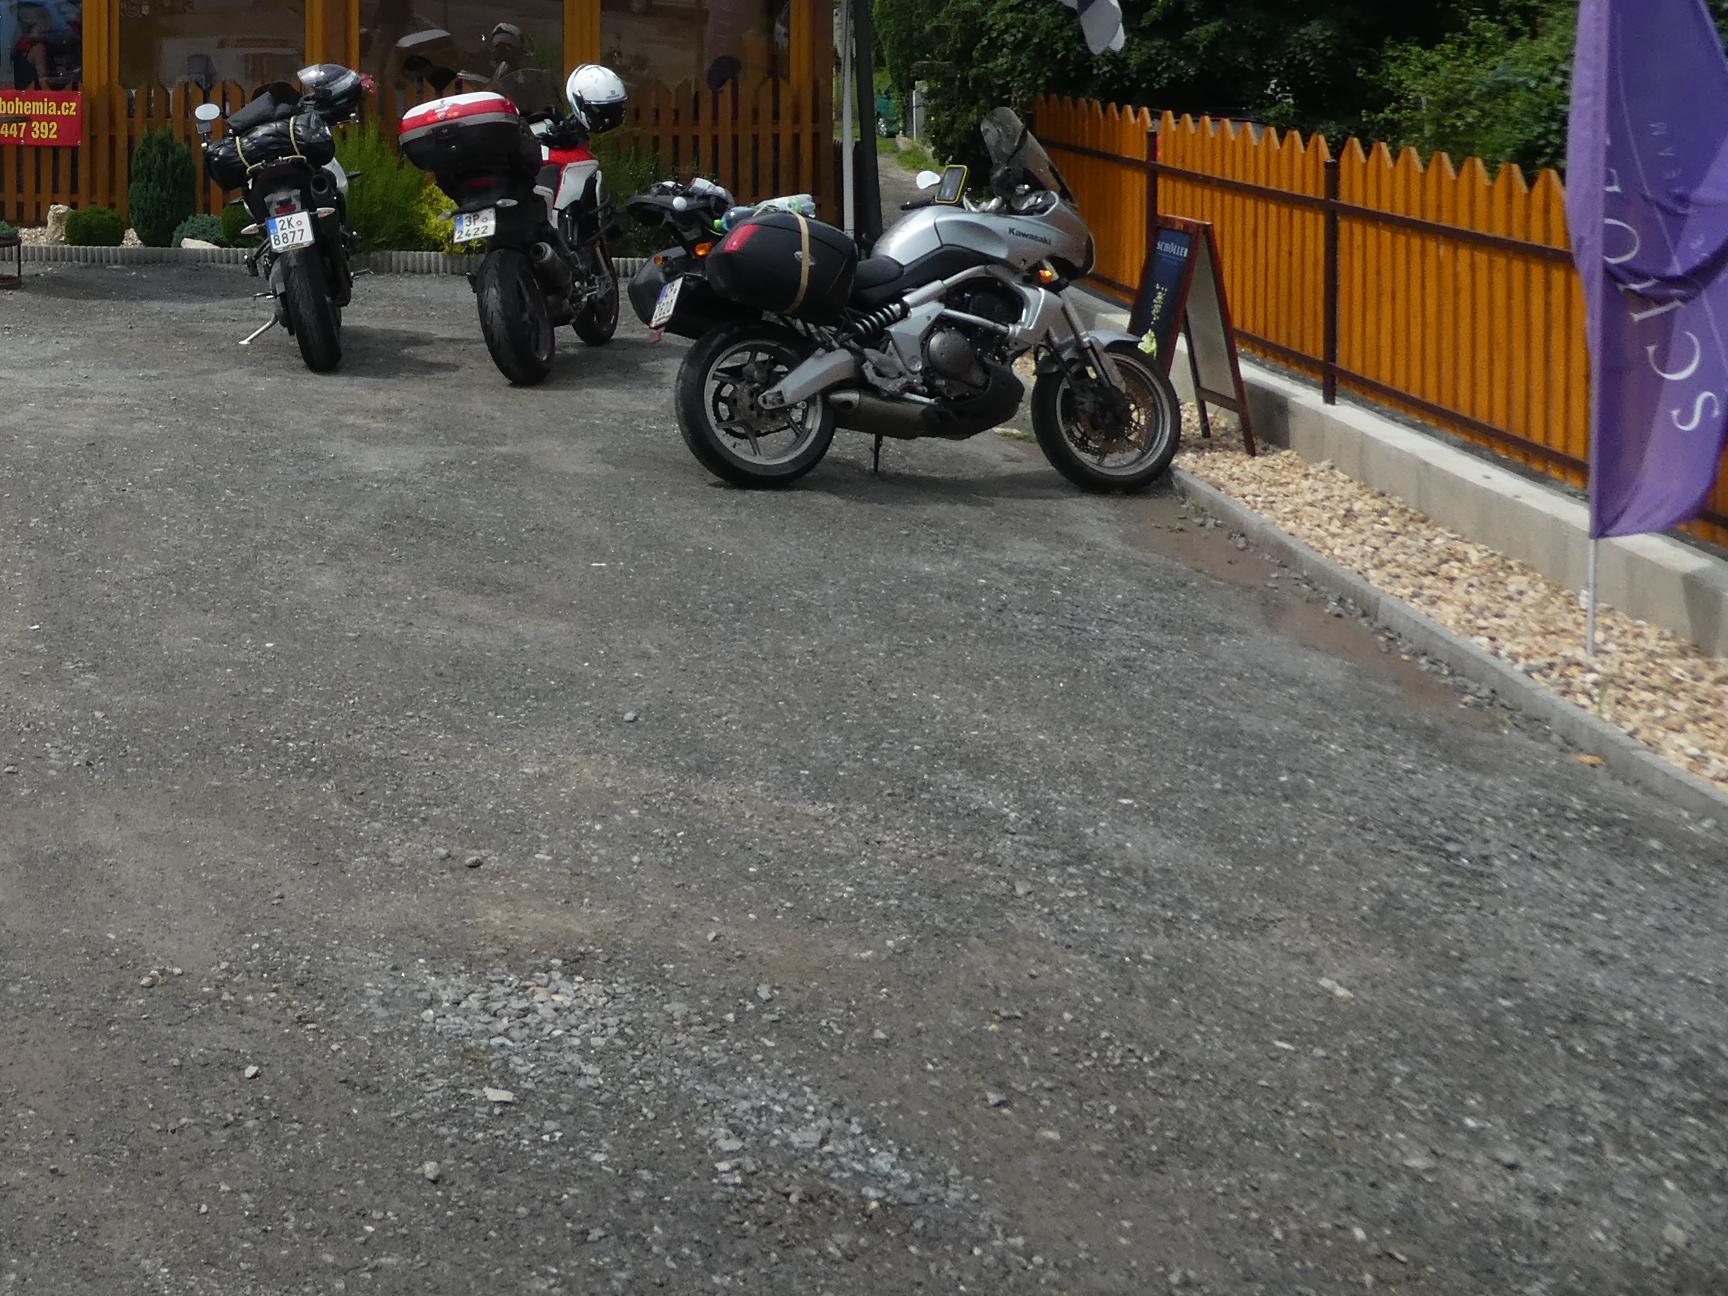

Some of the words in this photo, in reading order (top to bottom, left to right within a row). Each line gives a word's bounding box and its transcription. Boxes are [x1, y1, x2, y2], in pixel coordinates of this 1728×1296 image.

[0, 122, 27, 138] 447
[31, 121, 58, 139] 392
[279, 217, 294, 231] 2K
[465, 214, 480, 227] 3P
[273, 229, 304, 245] 8877
[457, 225, 488, 240] 2422
[1008, 226, 1052, 246] Kawasaki
